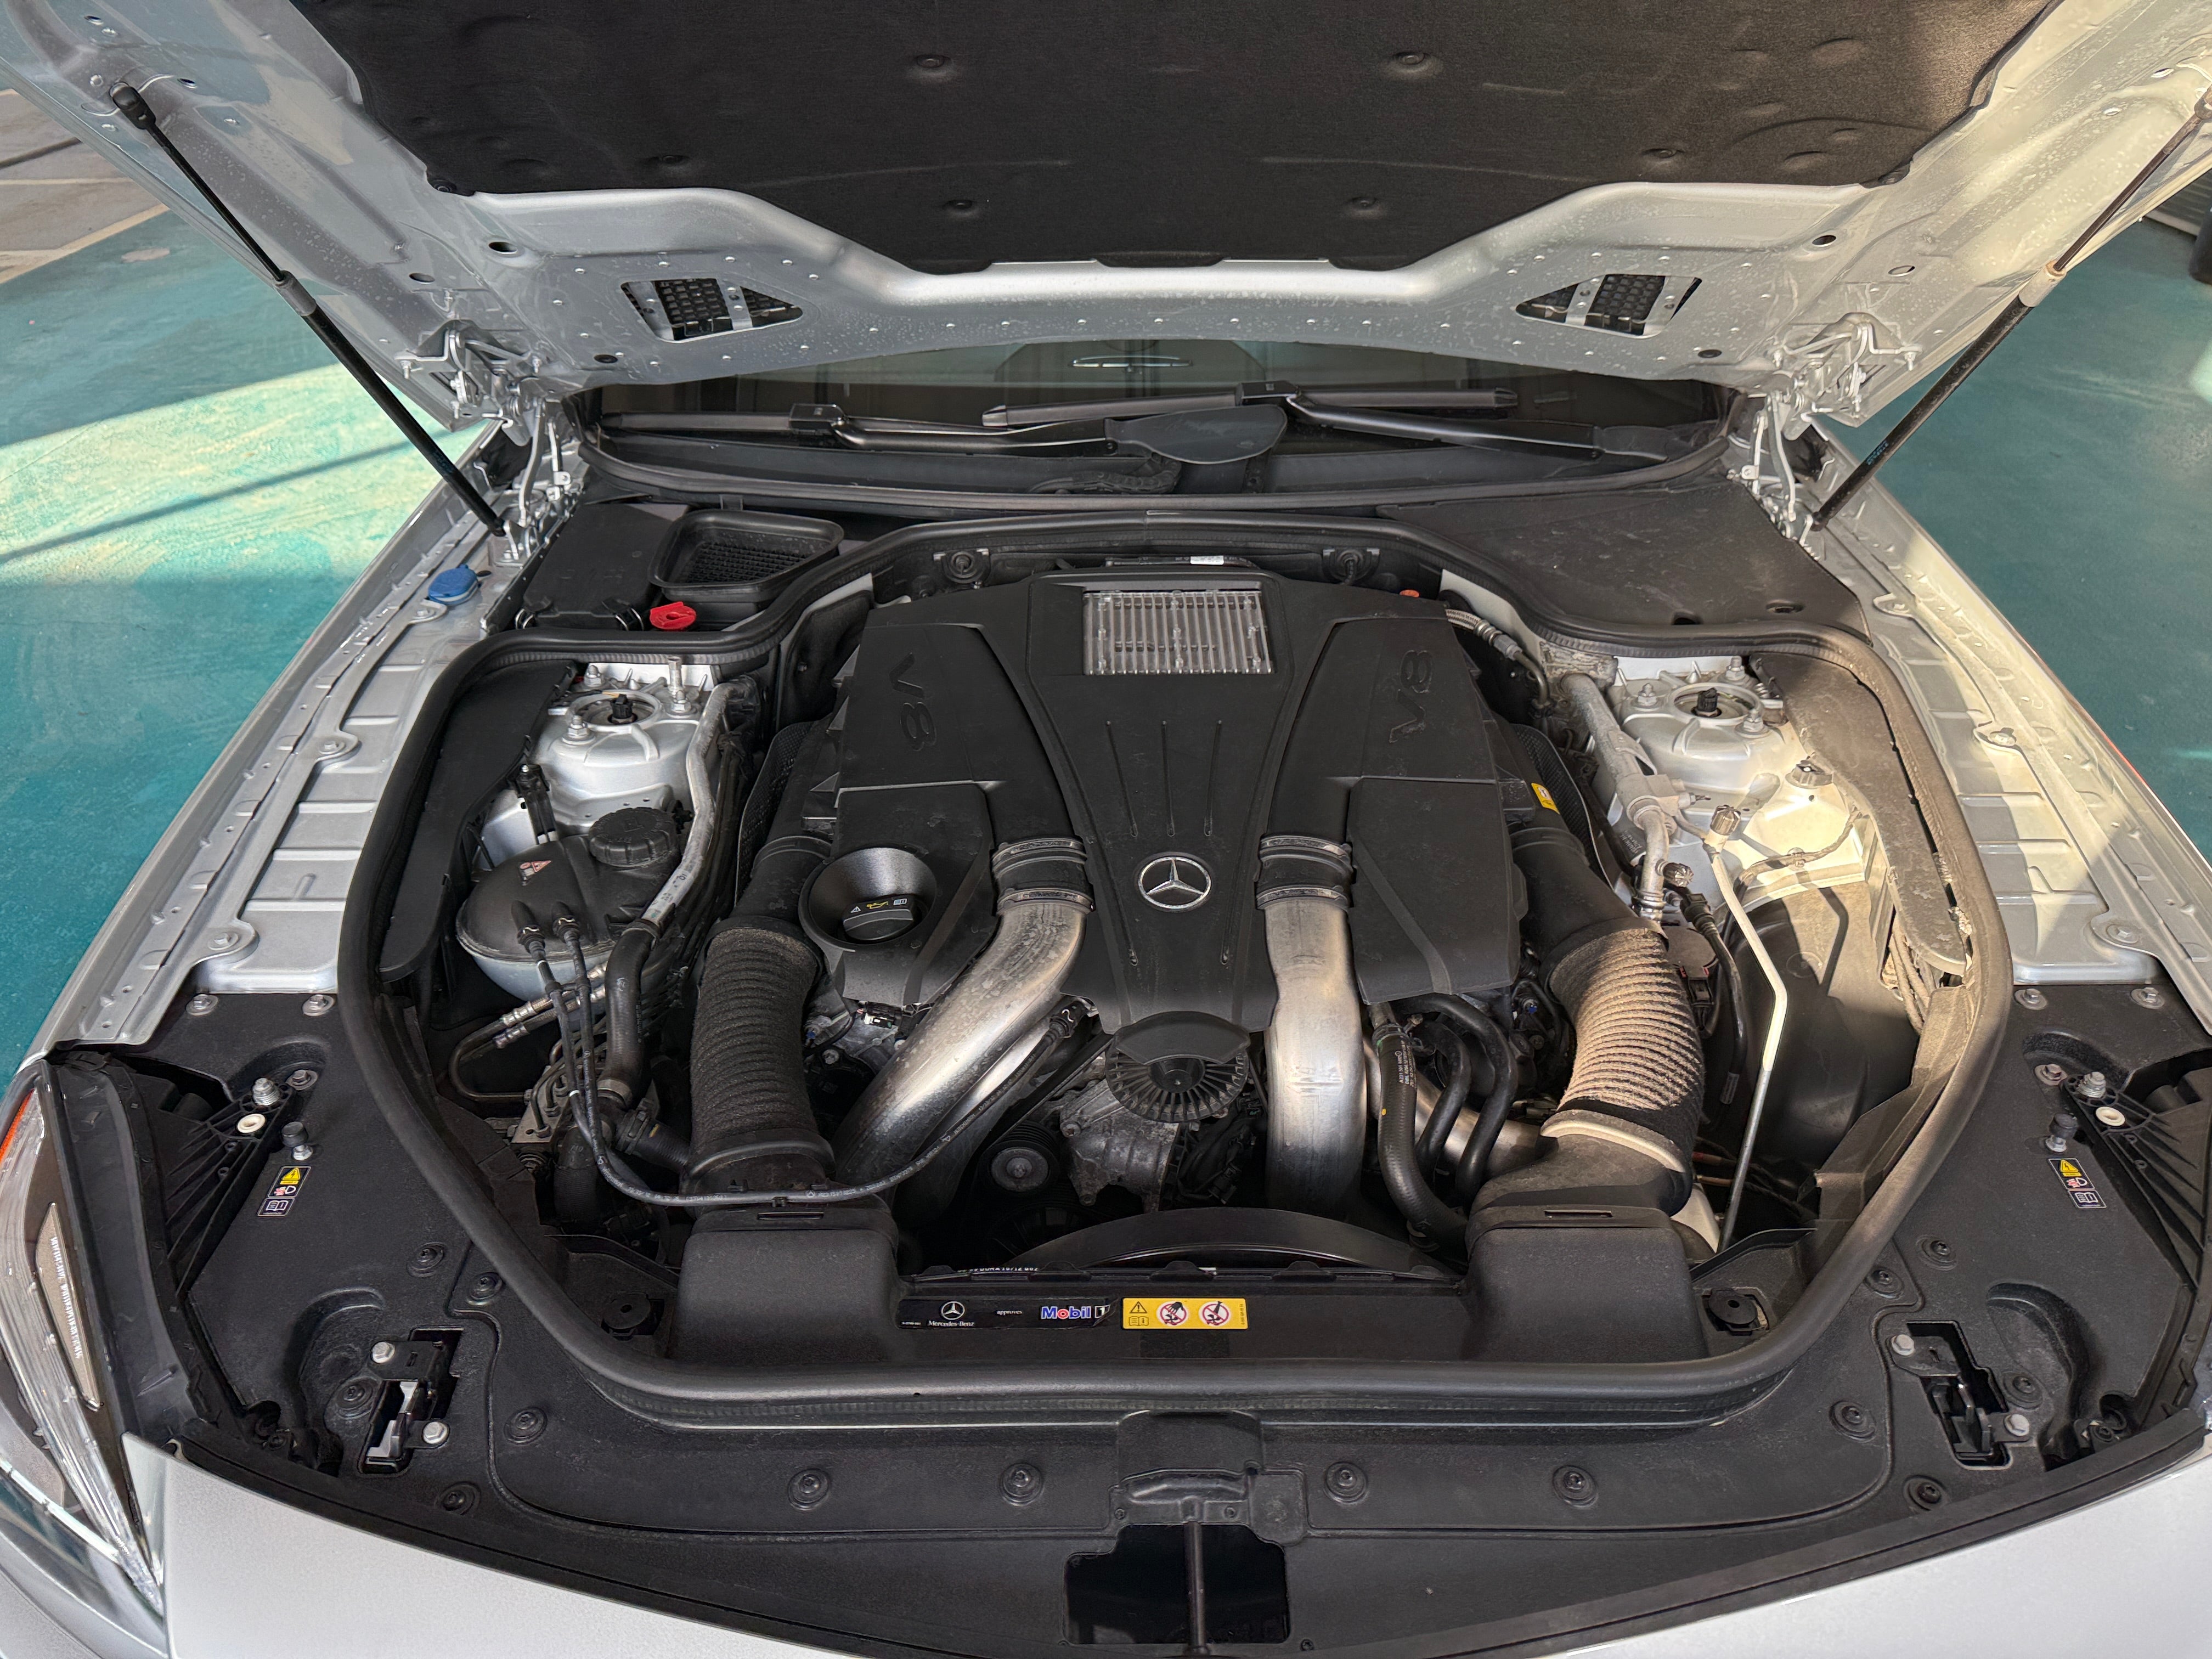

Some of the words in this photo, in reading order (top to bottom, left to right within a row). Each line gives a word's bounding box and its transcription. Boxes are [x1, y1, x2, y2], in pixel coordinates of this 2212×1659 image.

[889, 651, 936, 752] V8
[1389, 650, 1434, 743] V8
[1041, 1306, 1091, 1319] Mobil
